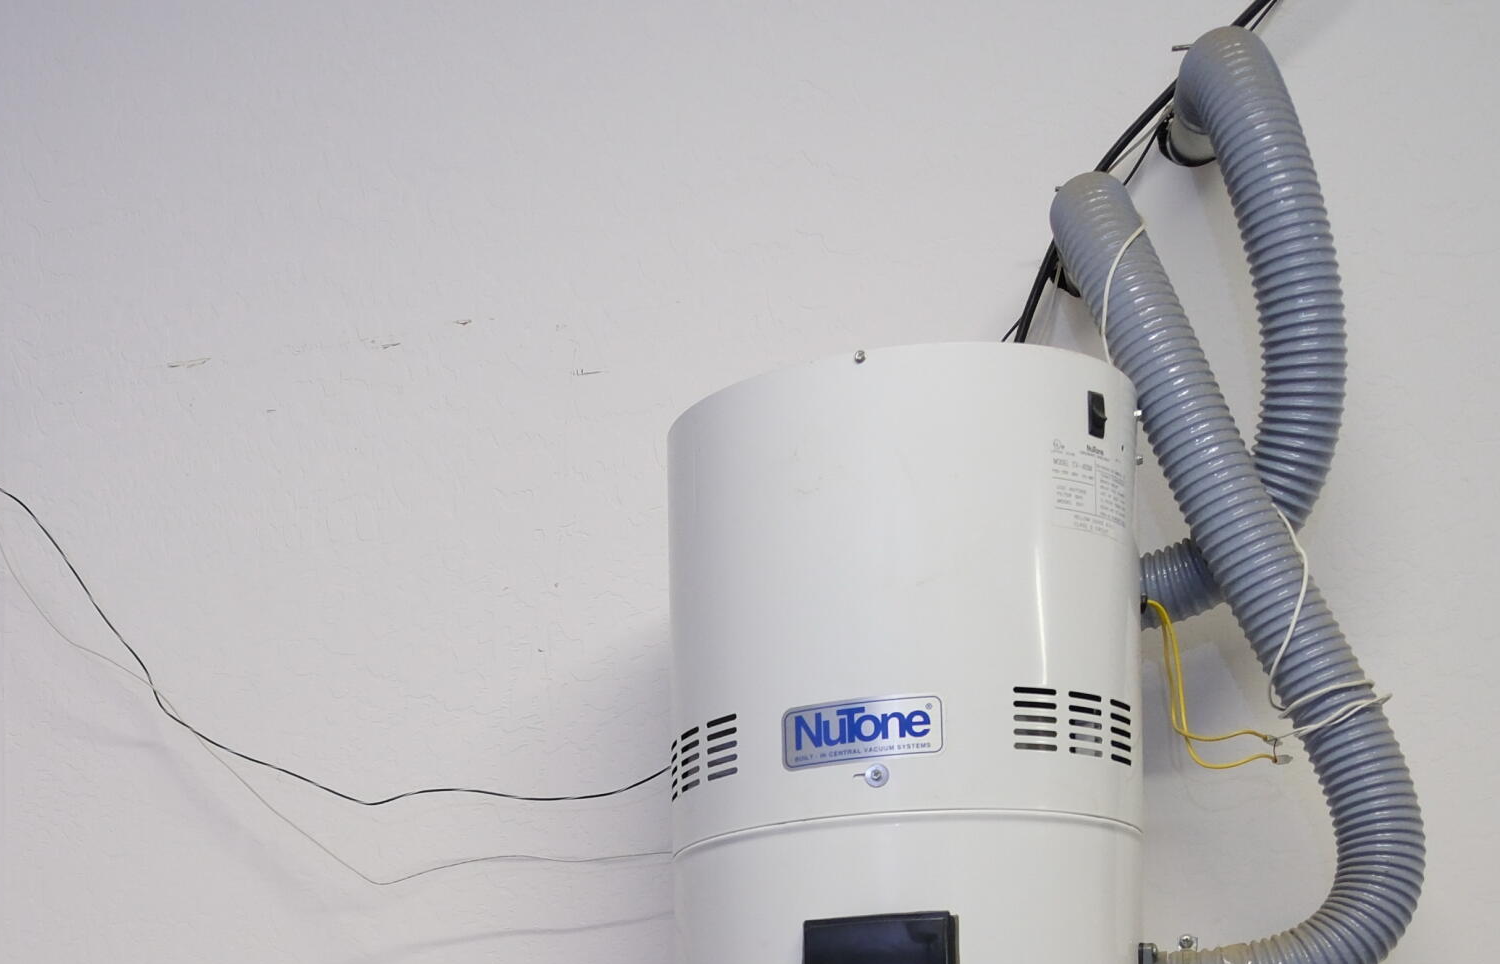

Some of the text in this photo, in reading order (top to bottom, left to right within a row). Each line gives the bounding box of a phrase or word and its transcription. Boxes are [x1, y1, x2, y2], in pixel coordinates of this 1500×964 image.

[795, 706, 931, 750] NuTone
[828, 749, 861, 758] CENTRAL
[864, 745, 894, 753] VACUUM
[897, 742, 931, 750] SYSTEMS
